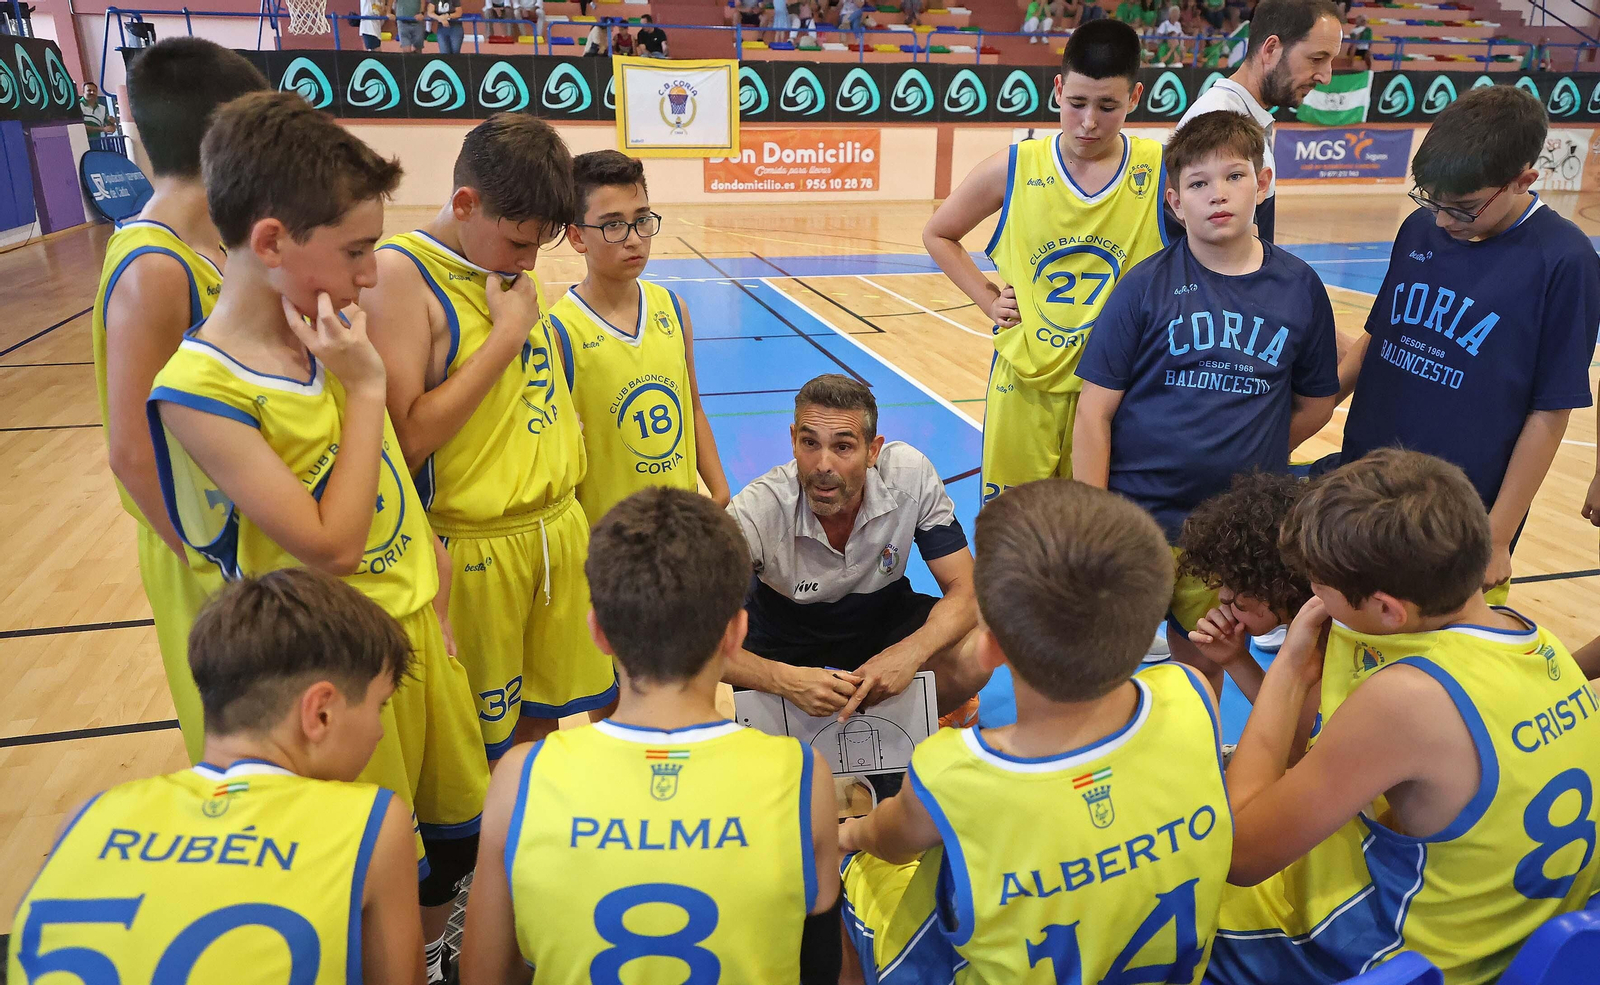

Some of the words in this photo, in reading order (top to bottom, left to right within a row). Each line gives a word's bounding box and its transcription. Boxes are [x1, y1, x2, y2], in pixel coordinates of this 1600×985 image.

[763, 141, 875, 164] Domicilio
[1295, 140, 1347, 161] MGS
[710, 179, 796, 190] dondomicilio.es
[806, 179, 827, 190] 956
[829, 179, 842, 189] 10
[844, 178, 858, 189] 28
[860, 178, 874, 189] 78
[1029, 240, 1056, 266] CLUB
[1045, 271, 1112, 306] 27
[1390, 282, 1501, 357] CORIA
[1036, 327, 1085, 349] CORI
[1167, 309, 1290, 368] CORIA
[1400, 335, 1427, 352] DESDE
[1427, 346, 1446, 359] 1968
[1198, 360, 1231, 370] DESDE
[1233, 363, 1254, 373] 1968
[1380, 339, 1465, 390] BALONCESTO
[609, 386, 629, 414] CLUB
[628, 374, 680, 397] BALONCEST
[1164, 370, 1271, 395] BALONCESTO
[632, 404, 673, 439] 18
[302, 454, 330, 486] LUB
[635, 452, 684, 475] CORIA
[982, 482, 1015, 506] 2
[478, 674, 523, 723] 32
[1511, 684, 1599, 753] CRISTI
[98, 825, 299, 871] RUBÉN
[569, 816, 749, 851] PALMA
[1513, 767, 1596, 899] 8
[999, 804, 1216, 906] ALBERTO
[17, 893, 321, 985] 50
[589, 882, 722, 985] 8
[1025, 877, 1206, 985] 14
